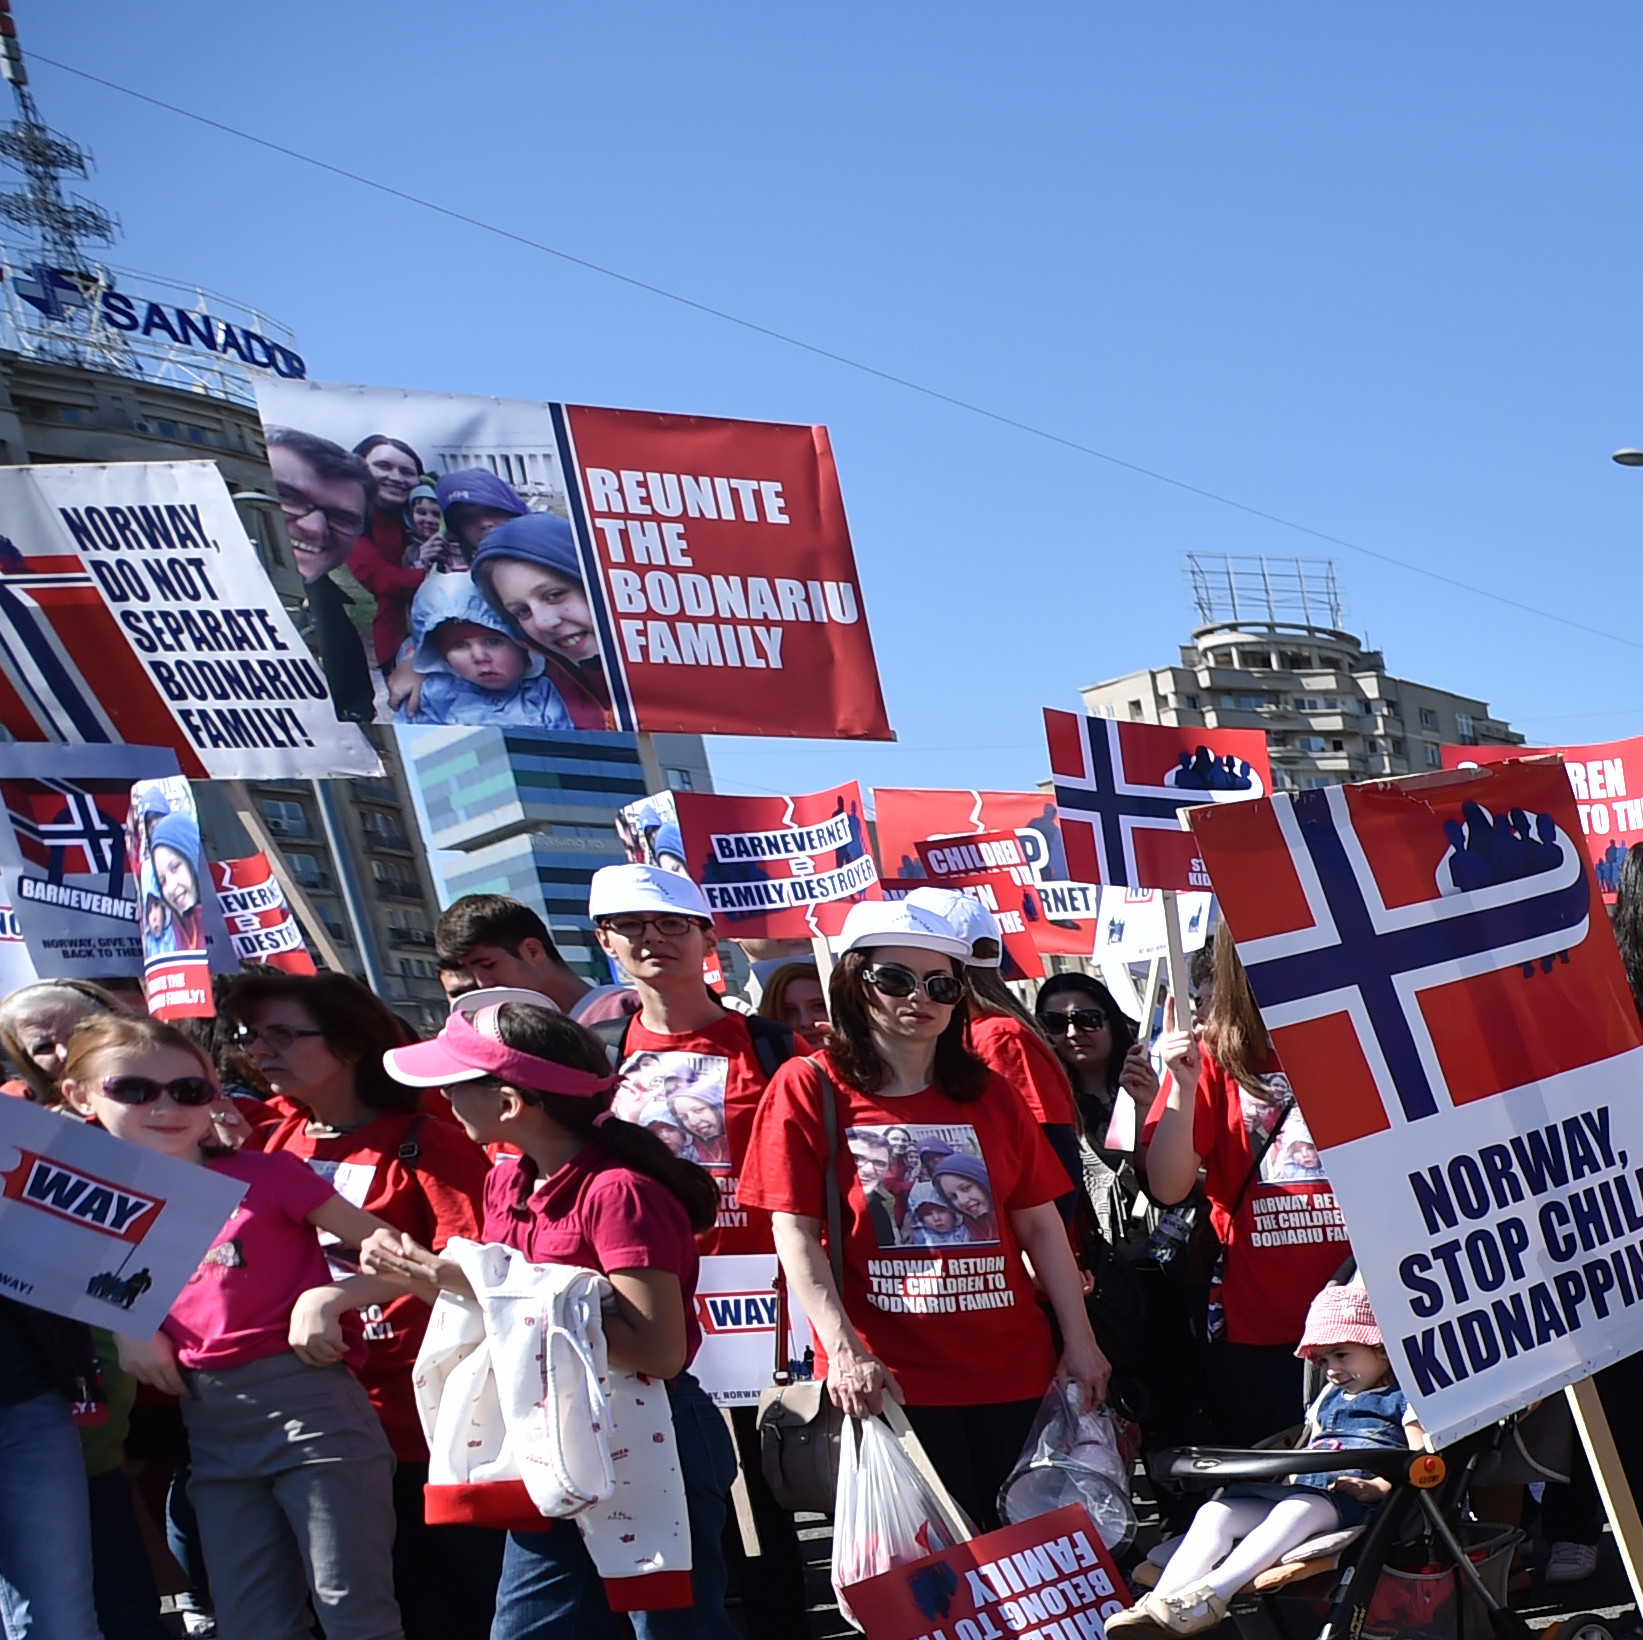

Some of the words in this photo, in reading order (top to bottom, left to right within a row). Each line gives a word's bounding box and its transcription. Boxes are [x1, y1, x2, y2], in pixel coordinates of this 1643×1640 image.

[101, 291, 306, 380] SANADOR
[585, 467, 791, 525] REUNITE
[58, 504, 221, 553] NORWAY,
[594, 518, 693, 567] THE
[88, 559, 150, 603] DO
[142, 557, 219, 601] NOT
[608, 569, 859, 624] BODNARIU
[120, 609, 289, 652] SEPARATE
[619, 619, 783, 669] FAMILY
[148, 659, 328, 701] BODNARIU
[176, 708, 315, 748] FAMILY!
[715, 817, 850, 859] BARNEVERNET
[1577, 803, 1610, 835] TO
[705, 882, 785, 909] FAMILY
[790, 858, 875, 901] DESTROYER
[62, 949, 95, 959] BACK
[98, 937, 127, 948] GIVE
[1407, 1105, 1629, 1236] NORWAY,
[26, 1163, 147, 1230] WAY
[1252, 1195, 1312, 1215] NORWAY,
[1251, 1227, 1324, 1247] BODNARIU
[1254, 1214, 1278, 1231] THE
[868, 1259, 946, 1277] NORWAY,
[948, 1256, 1005, 1276] RETURN
[870, 1277, 903, 1295] THE
[906, 1277, 984, 1295] CHILDREN
[987, 1273, 1006, 1290] TO
[1398, 1216, 1530, 1319] STOP
[867, 1293, 956, 1313] BODNARIU
[959, 1291, 1015, 1312] FAMILY!
[964, 1530, 1099, 1609] FAMILY
[998, 1568, 1115, 1631] BELONG
